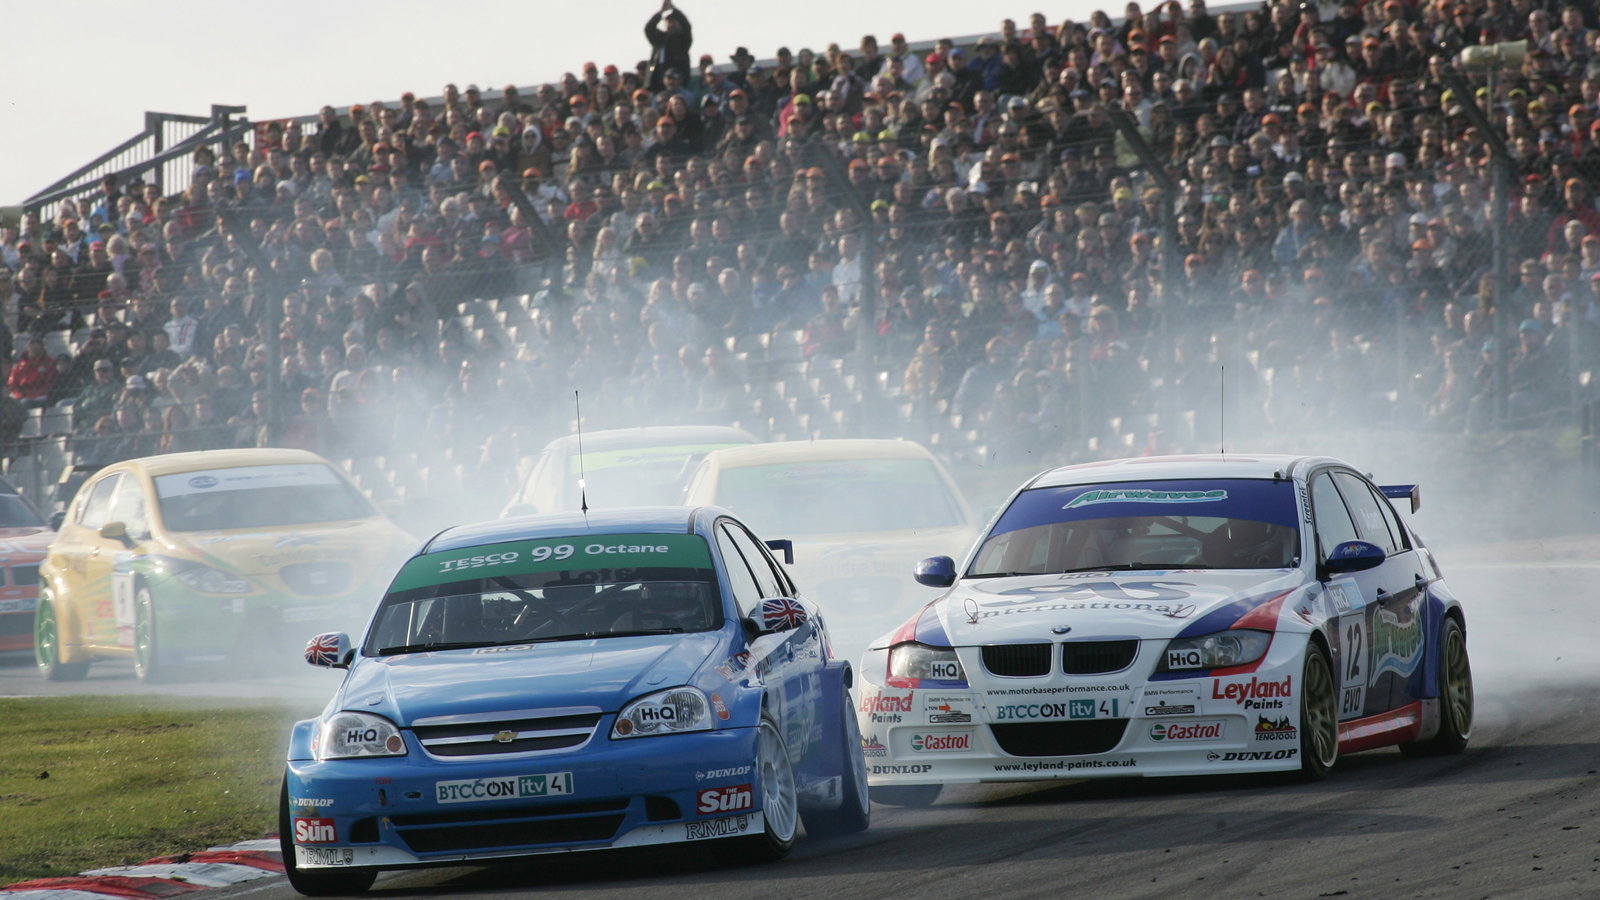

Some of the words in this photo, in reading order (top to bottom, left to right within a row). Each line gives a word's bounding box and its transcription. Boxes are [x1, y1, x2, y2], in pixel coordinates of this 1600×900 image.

[1063, 489, 1229, 509] Airwaves
[439, 551, 520, 571] TESCO
[531, 544, 575, 562] 99
[584, 543, 669, 555] Octane
[1169, 651, 1200, 666] HiQ
[1346, 623, 1362, 680] 12
[932, 663, 957, 677] HiQ
[987, 683, 1130, 696] www.motorbaseperformance.co.uk
[1212, 675, 1291, 704] Leyland
[859, 690, 914, 717] Leyland
[996, 703, 1067, 719] BTCCON
[1071, 702, 1093, 716] itv
[1099, 700, 1109, 715] 4
[1244, 699, 1283, 710] Paints
[1343, 689, 1361, 713] evo
[642, 706, 675, 721] HiQ
[872, 712, 902, 723] Paints
[347, 729, 377, 743] HiQ
[1167, 722, 1221, 740] Castrol
[925, 734, 969, 750] Castrol
[1222, 748, 1298, 761] DUNLOP
[705, 766, 751, 779] DUNLOP
[872, 765, 933, 774] DUNLOP
[994, 758, 1137, 772] www.leyland-paints.co.uk
[521, 778, 544, 794] itv
[550, 775, 562, 792] 4
[298, 798, 335, 807] DUNLOP
[699, 790, 751, 813] Sun
[296, 820, 335, 842] Sun
[685, 819, 738, 840] RML
[305, 847, 344, 866] RML
